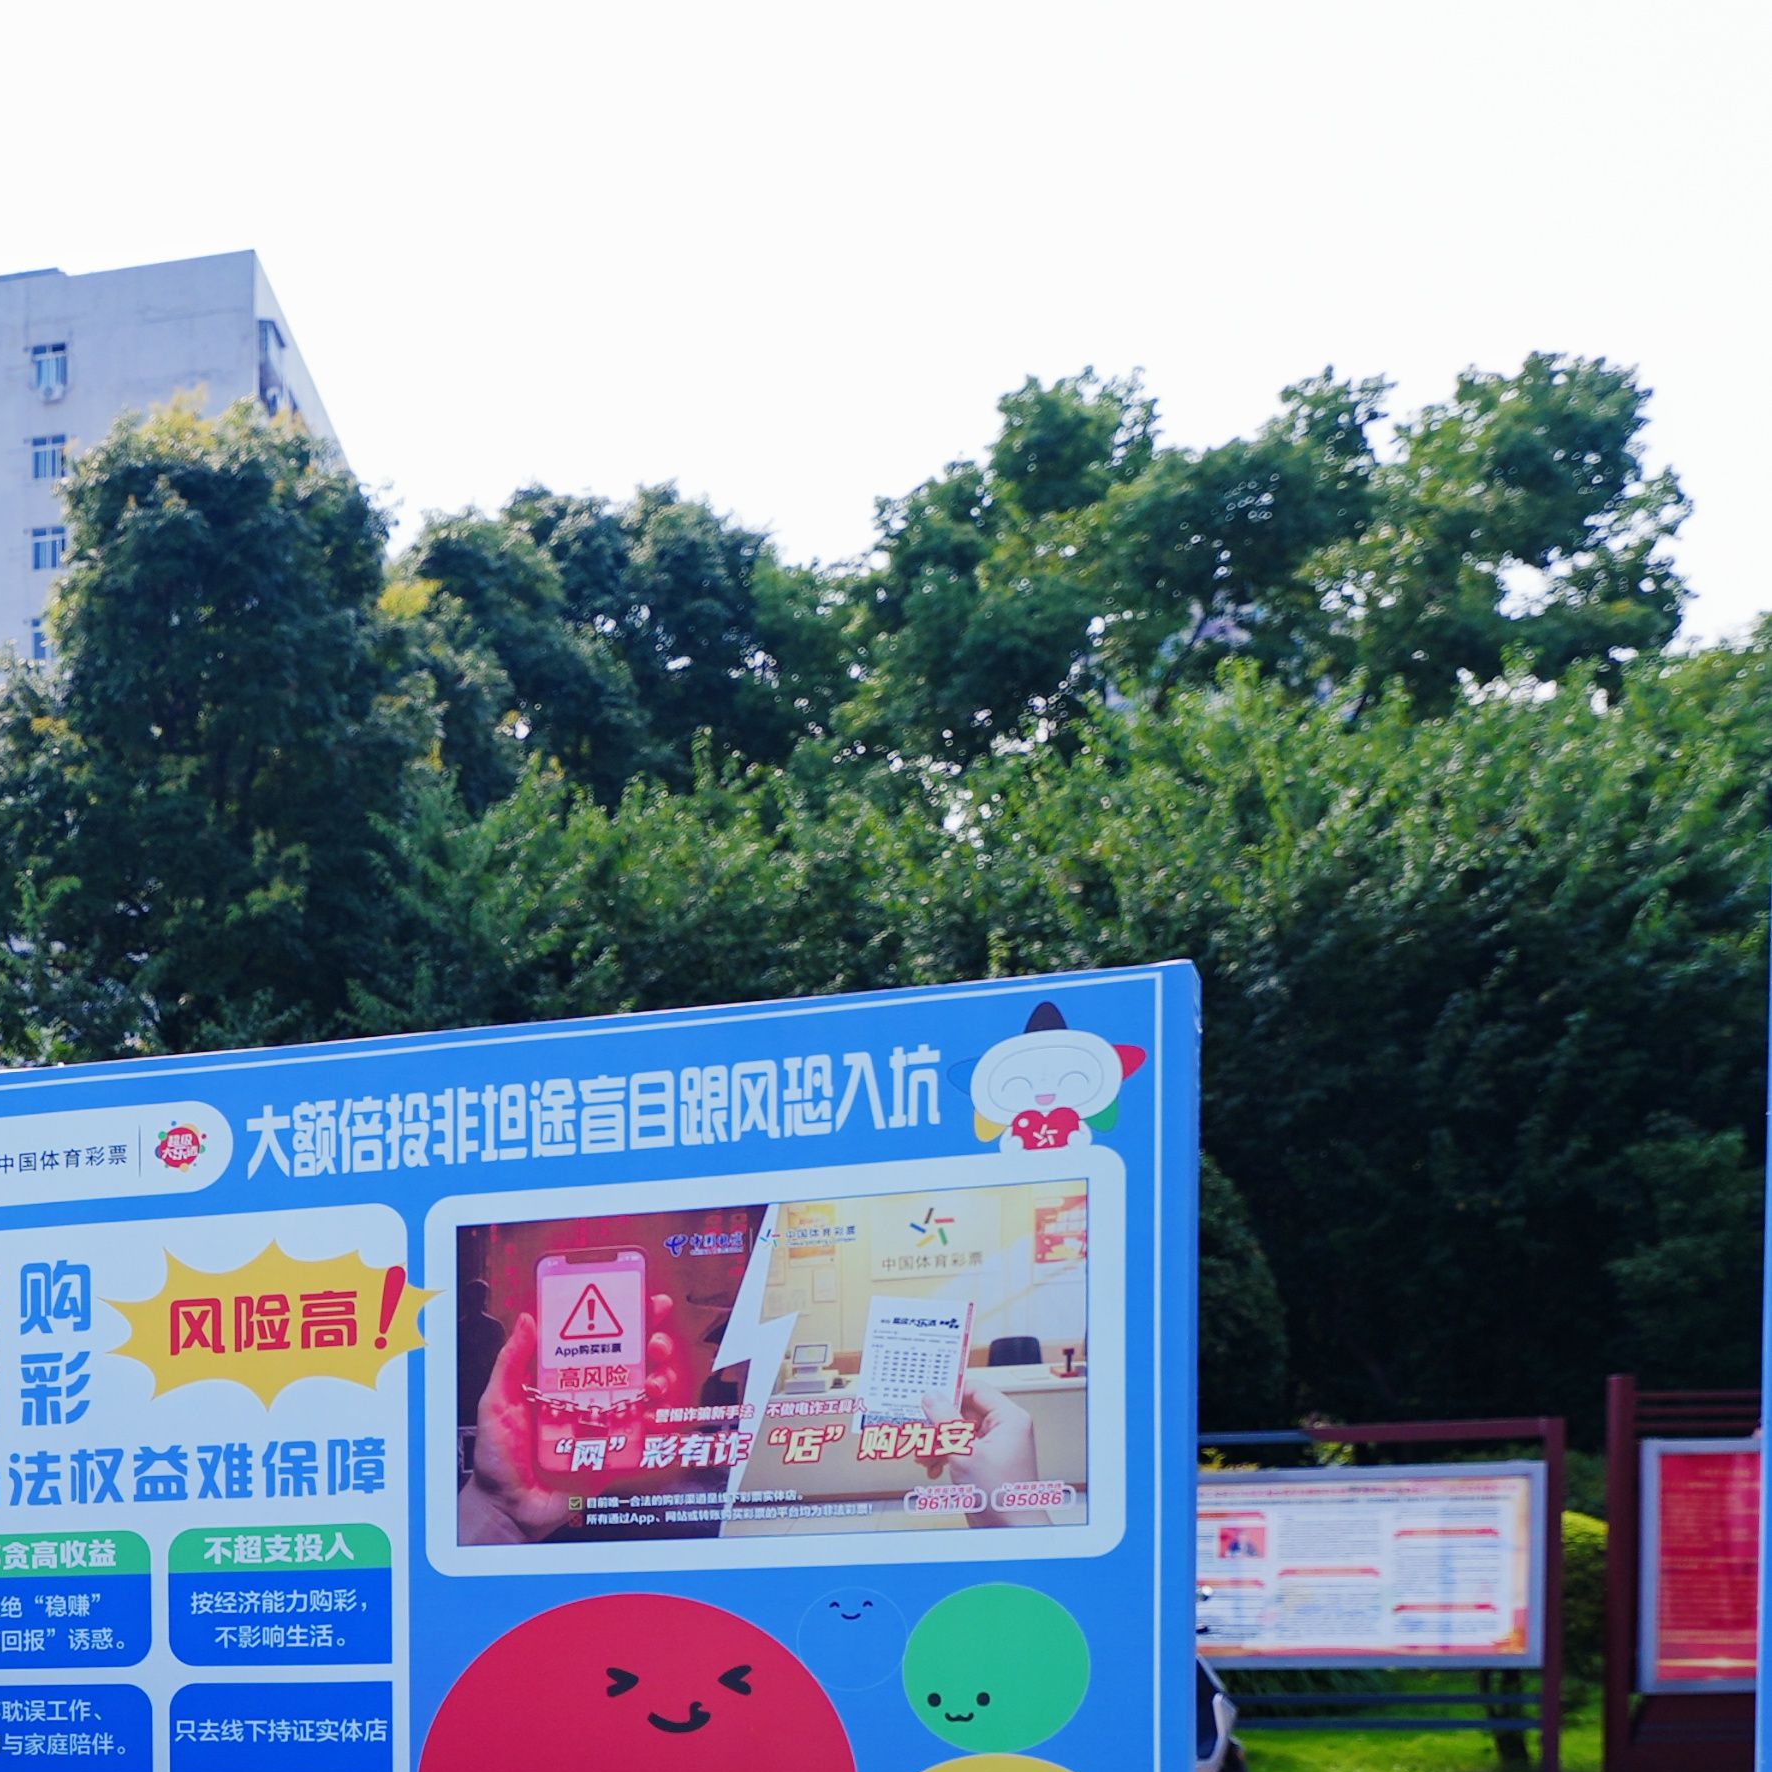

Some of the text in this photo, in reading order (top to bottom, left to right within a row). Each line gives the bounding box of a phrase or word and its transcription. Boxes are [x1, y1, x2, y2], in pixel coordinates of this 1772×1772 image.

[246, 1043, 941, 1181] 大额倍投非坦途盲目跟风恐入坑
[881, 1251, 984, 1271] 中国体育彩票
[170, 1265, 406, 1356] 风险高！
[555, 1343, 622, 1358] App购买彩票
[559, 1366, 630, 1390] 高风险
[918, 1496, 974, 1510] 96110
[1005, 1492, 1062, 1507] 95086
[203, 1532, 355, 1566] 不超支投入
[190, 1588, 368, 1616] 按经济能力购彩，
[214, 1625, 347, 1650] 不影响生活。
[175, 1717, 388, 1744] 只去线下持证实体店
